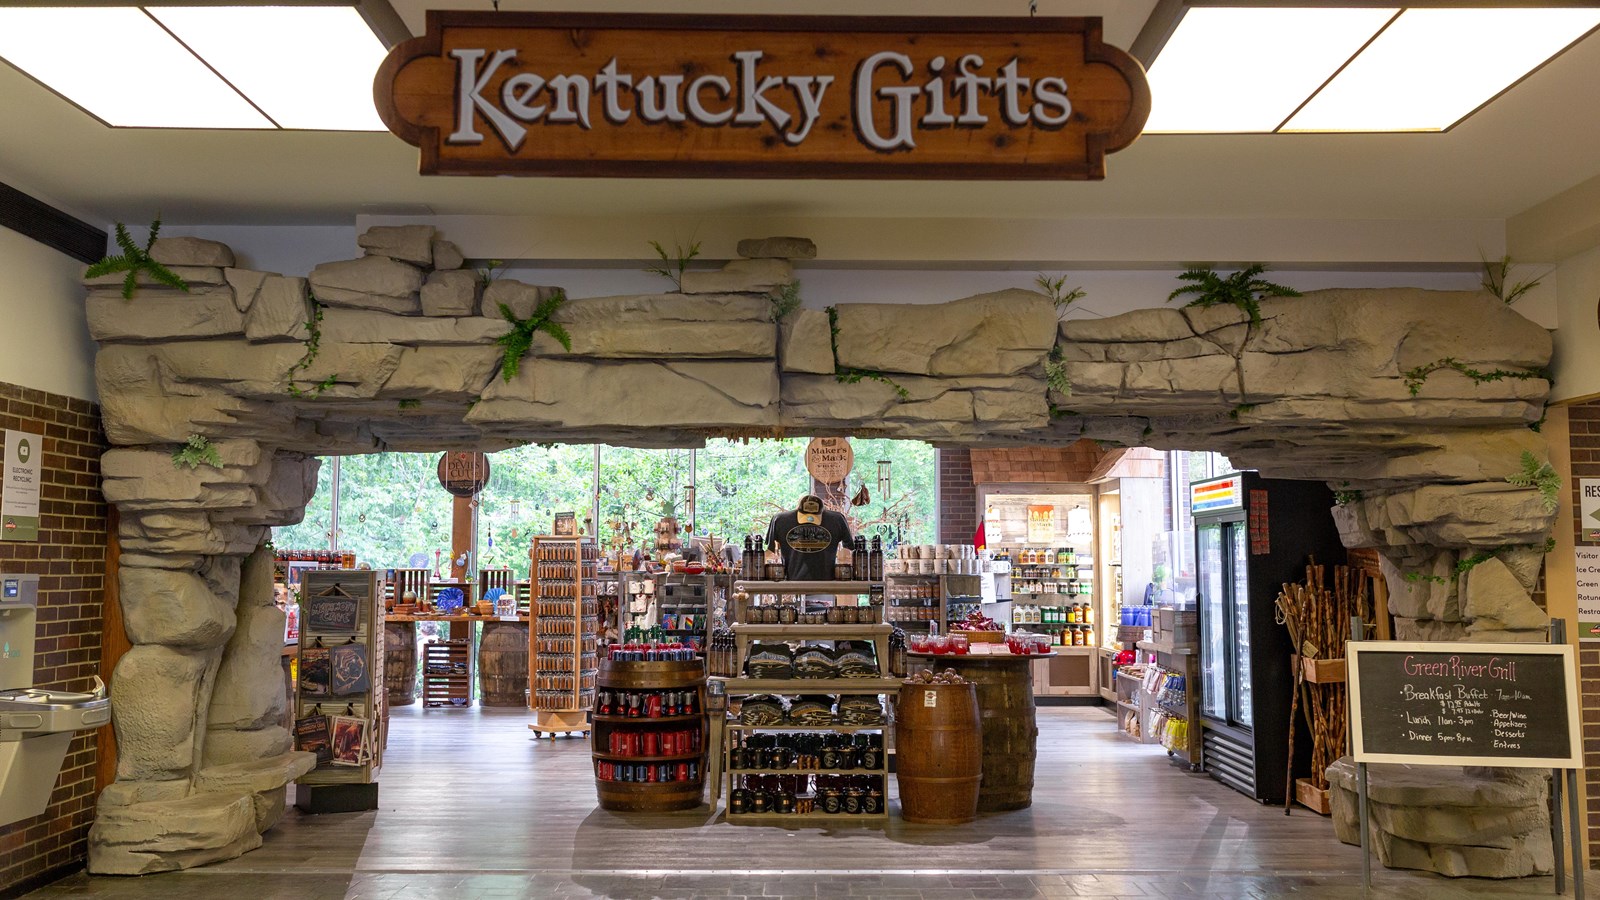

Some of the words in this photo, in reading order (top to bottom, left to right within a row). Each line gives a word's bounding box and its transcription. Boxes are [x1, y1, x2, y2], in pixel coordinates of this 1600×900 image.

[448, 48, 834, 151] Kentucky
[857, 51, 1073, 149] Gifts
[448, 459, 480, 470] DEVILS
[12, 466, 32, 475] ELECTRONIC
[1404, 655, 1448, 676] Green
[1450, 655, 1486, 681] River
[1488, 657, 1516, 682] Grill
[1404, 683, 1452, 701] Breakfast
[1454, 684, 1488, 700] Buffet
[1406, 711, 1432, 726] Lunch
[1492, 708, 1528, 721] Beer/Wine
[1494, 719, 1528, 729] Appetizers
[1408, 730, 1432, 741] Dinner
[1494, 728, 1526, 739] Desserts
[1494, 740, 1520, 750] Entrees
